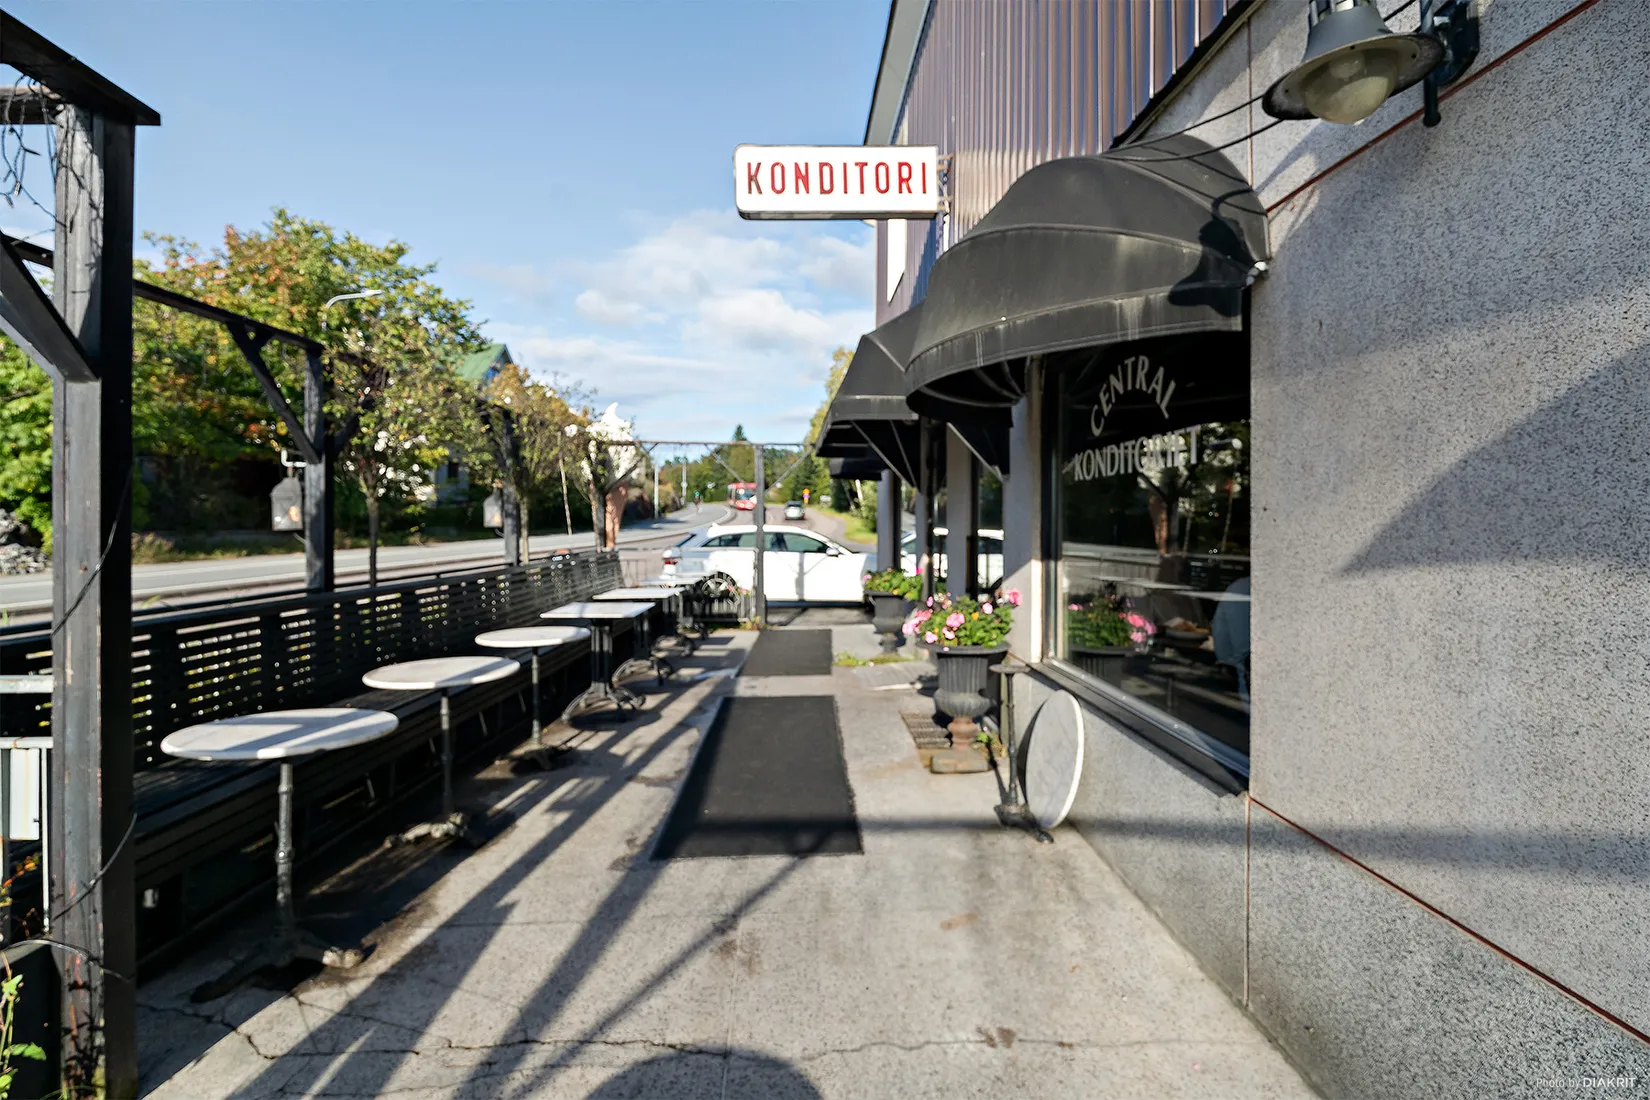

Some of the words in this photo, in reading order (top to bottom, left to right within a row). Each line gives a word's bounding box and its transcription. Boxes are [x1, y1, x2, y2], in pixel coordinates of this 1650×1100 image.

[747, 162, 927, 194] KONDITORI
[1090, 355, 1176, 437] CENTRAL
[1073, 424, 1201, 481] KONDITORIET
